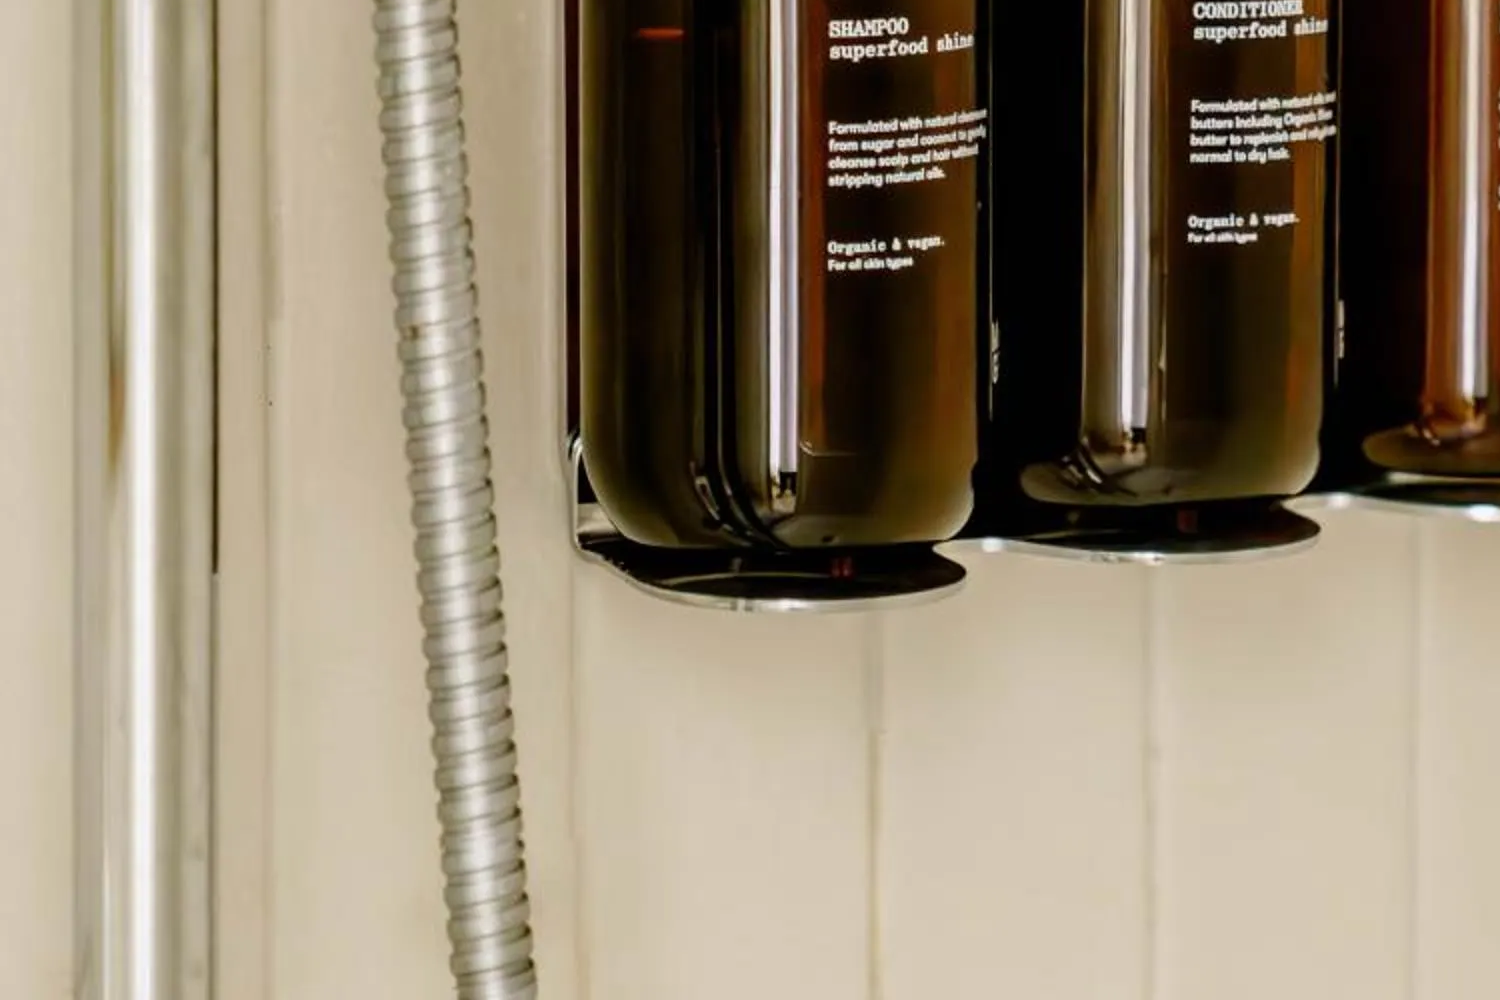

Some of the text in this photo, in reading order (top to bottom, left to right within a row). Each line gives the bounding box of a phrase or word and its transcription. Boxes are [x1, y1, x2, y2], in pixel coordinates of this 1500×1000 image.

[828, 17, 909, 38] SHAMPOO
[1193, 19, 1287, 44] superfood
[829, 36, 929, 63] superfood
[1190, 99, 1258, 113] Formulated
[1258, 97, 1281, 111] with
[828, 118, 899, 135] Formulated
[900, 117, 923, 131] with
[925, 112, 957, 128] natural
[1190, 115, 1234, 130] butters
[1234, 113, 1283, 129] including
[829, 138, 859, 152] from
[861, 138, 896, 153] sugar
[897, 134, 919, 148] and
[1189, 133, 1229, 147] butter
[1229, 134, 1243, 146] to
[828, 155, 877, 170] cleanse
[878, 152, 909, 168] scalp
[910, 150, 931, 164] and
[1189, 149, 1233, 164] normal
[1234, 149, 1247, 163] to
[1247, 148, 1267, 165] dry
[828, 172, 883, 188] stripping
[885, 168, 925, 184] natural
[1187, 212, 1245, 232] Organic
[827, 239, 887, 257] Organic
[827, 258, 847, 271] For
[848, 257, 863, 270] all
[863, 257, 885, 270] skin
